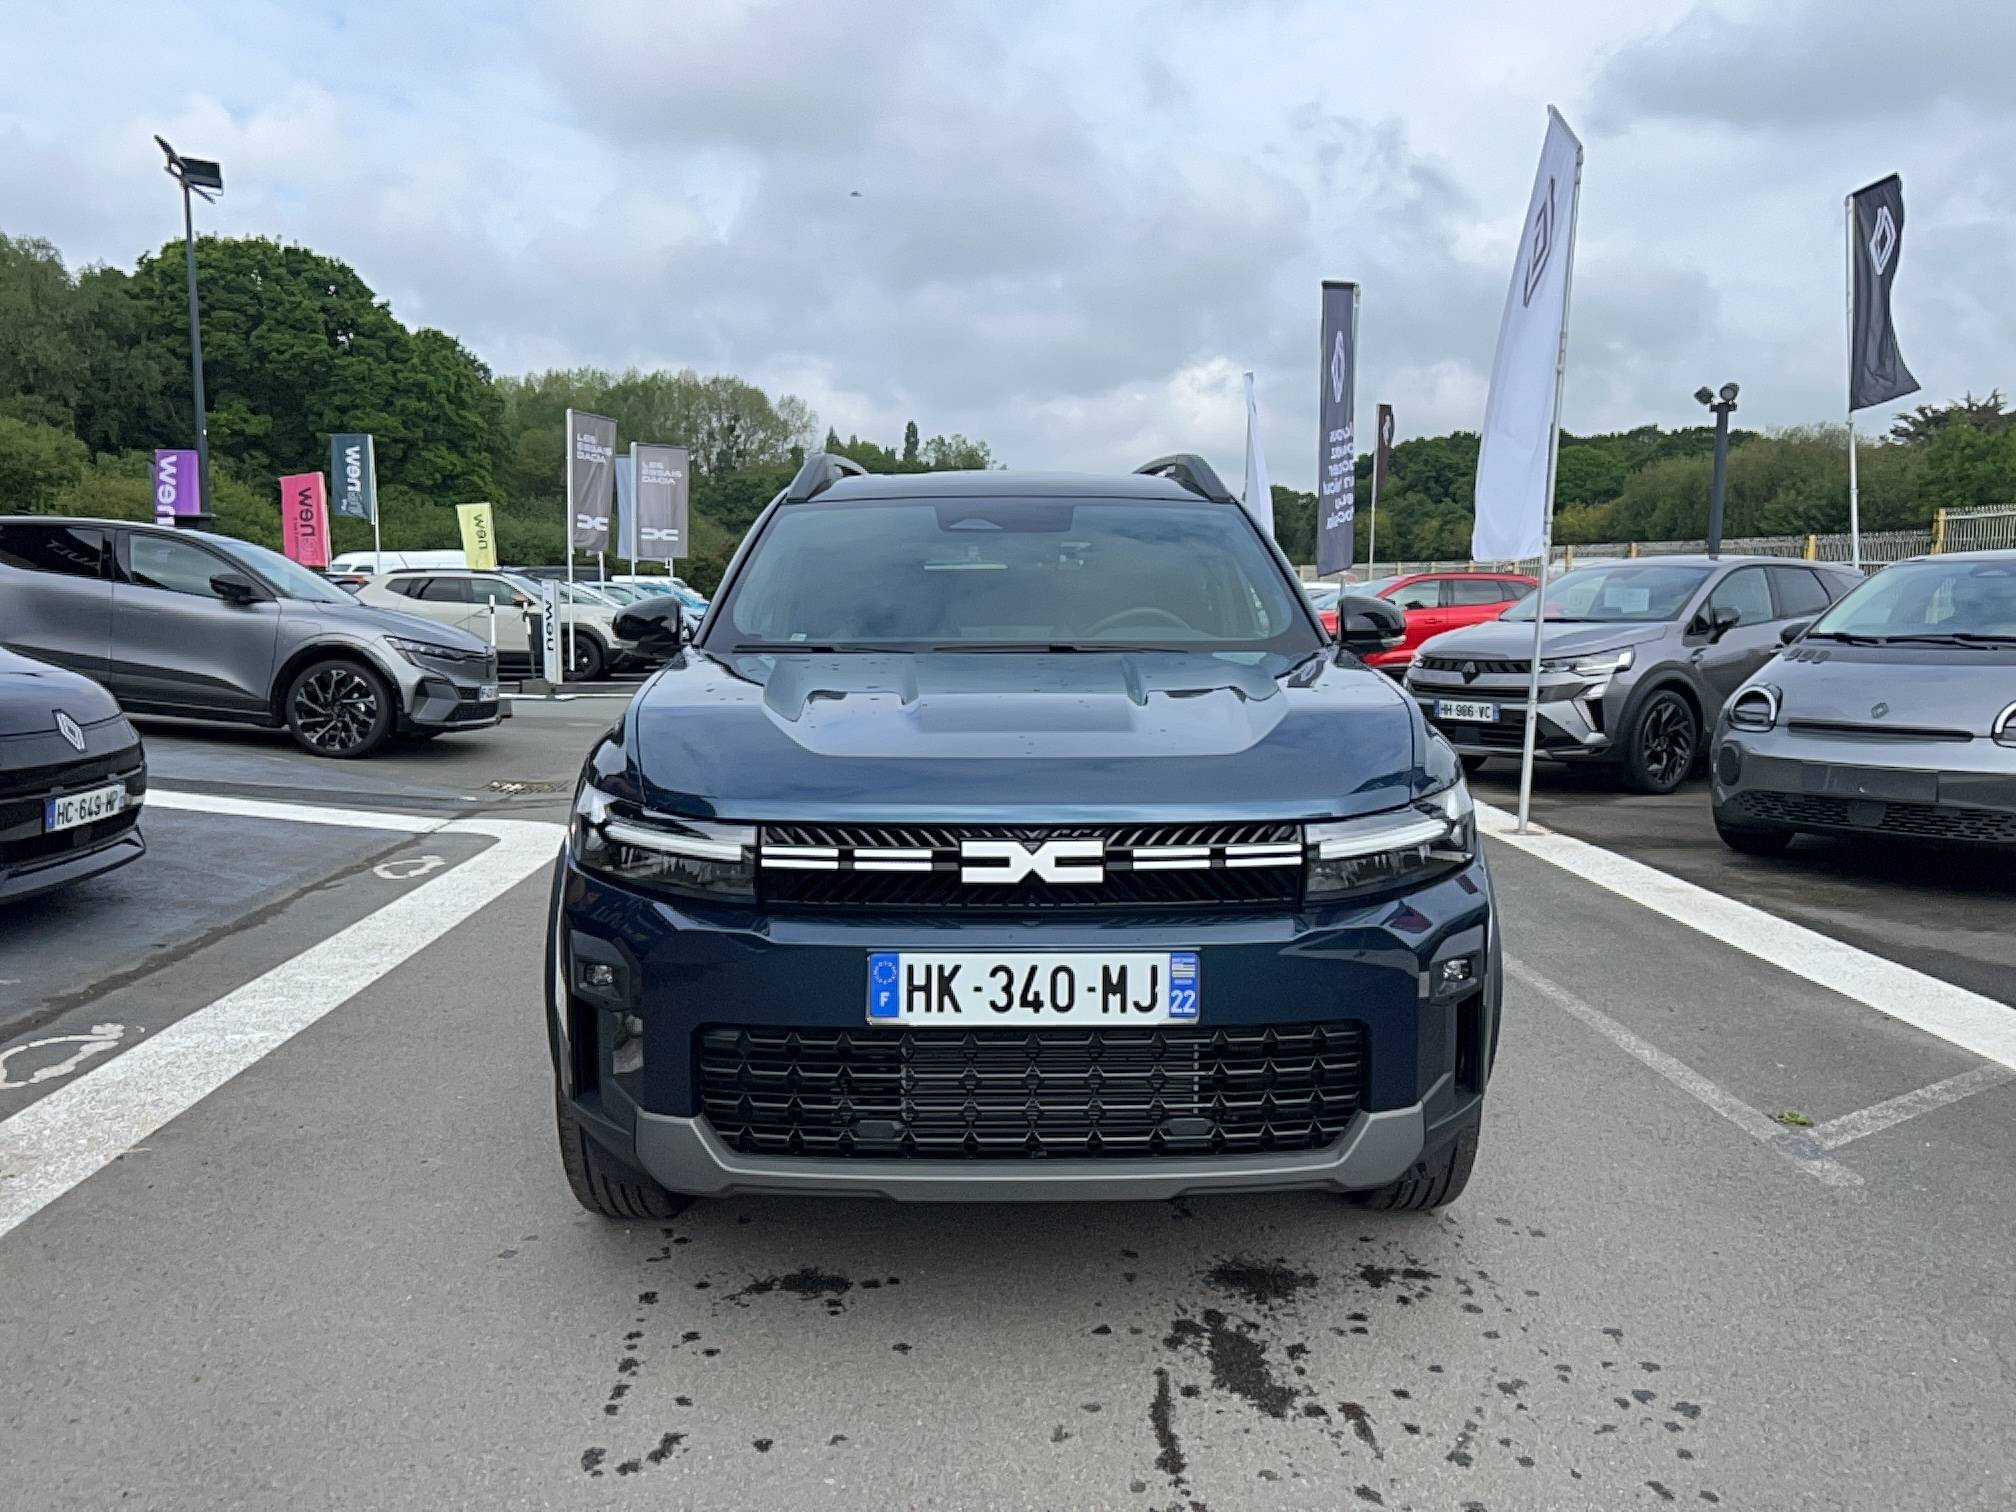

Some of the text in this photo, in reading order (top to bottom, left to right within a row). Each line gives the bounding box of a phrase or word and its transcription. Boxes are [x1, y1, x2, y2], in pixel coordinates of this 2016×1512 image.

[545, 600, 554, 651] new
[880, 964, 1196, 1014] F HK-340-MJ 22
